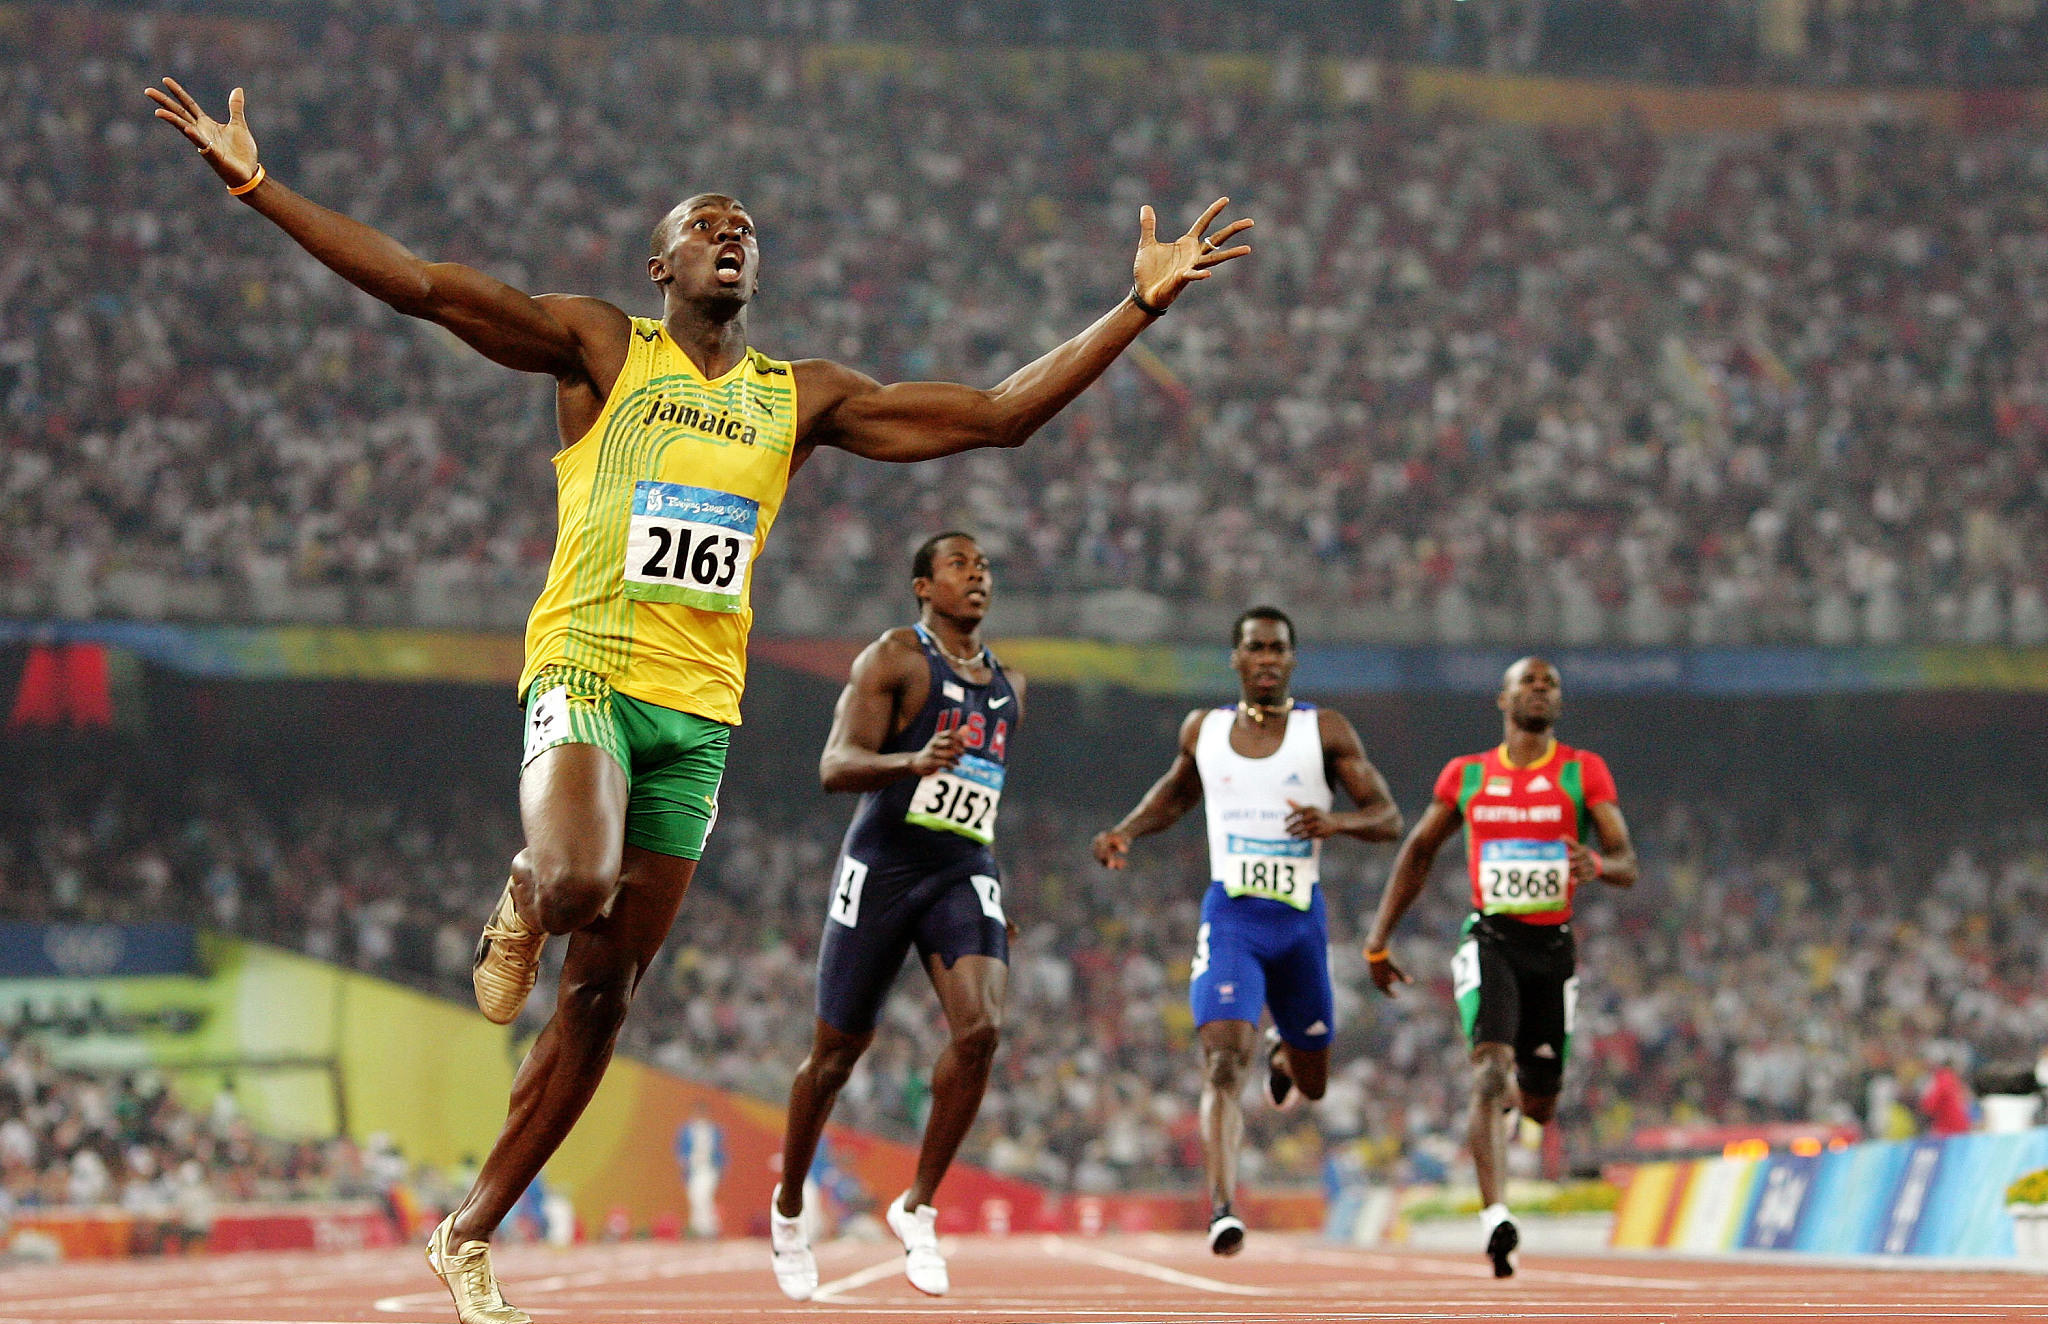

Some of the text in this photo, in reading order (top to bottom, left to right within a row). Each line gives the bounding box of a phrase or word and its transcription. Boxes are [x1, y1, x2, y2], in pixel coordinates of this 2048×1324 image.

[643, 394, 757, 446] jamaica
[666, 496, 701, 514] Beijing
[641, 526, 740, 588] 2163
[934, 707, 1007, 762] USA
[926, 780, 991, 829] 3152
[1242, 862, 1295, 895] 1813
[1491, 869, 1560, 898] 2868
